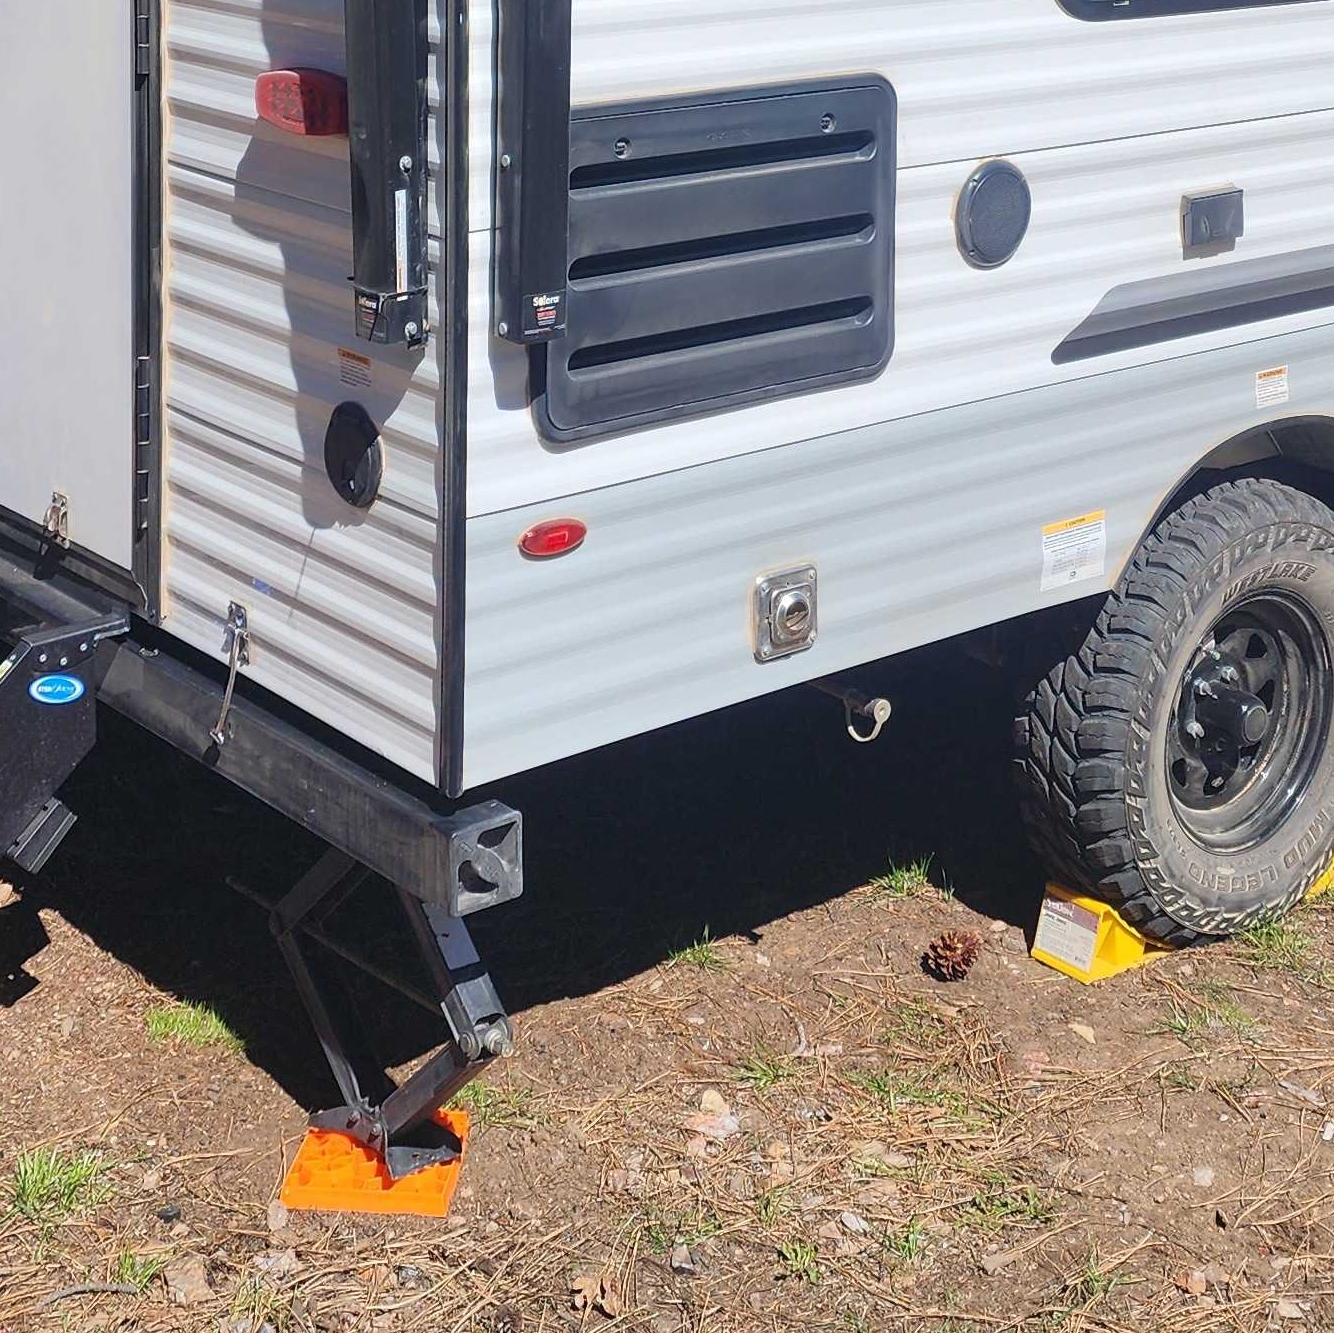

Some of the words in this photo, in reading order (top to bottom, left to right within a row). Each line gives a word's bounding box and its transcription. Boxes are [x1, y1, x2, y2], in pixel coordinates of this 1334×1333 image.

[1221, 560, 1316, 605] WESTLAKE
[1284, 810, 1331, 868] MUD
[1189, 864, 1279, 893] LEGEND
